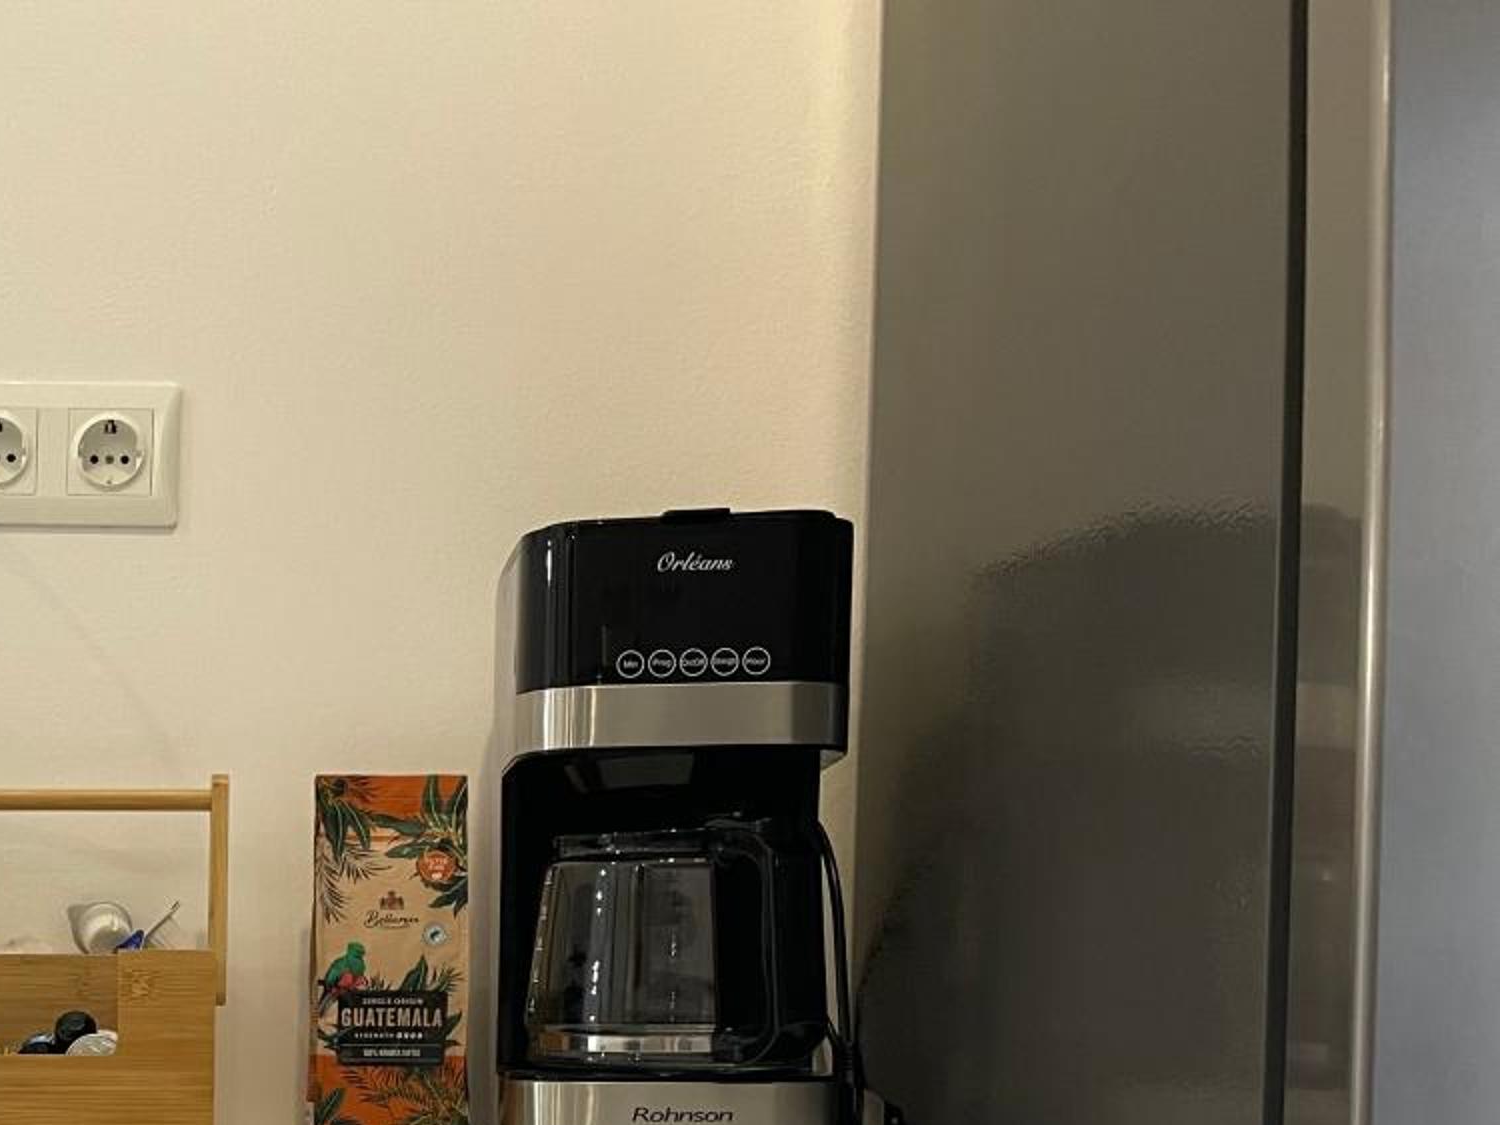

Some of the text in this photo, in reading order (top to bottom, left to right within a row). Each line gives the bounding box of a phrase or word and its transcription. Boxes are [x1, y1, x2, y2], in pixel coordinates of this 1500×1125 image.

[657, 551, 733, 572] Orléans
[341, 1007, 442, 1028] GUATEMALA
[632, 1107, 733, 1123] Rohnson
